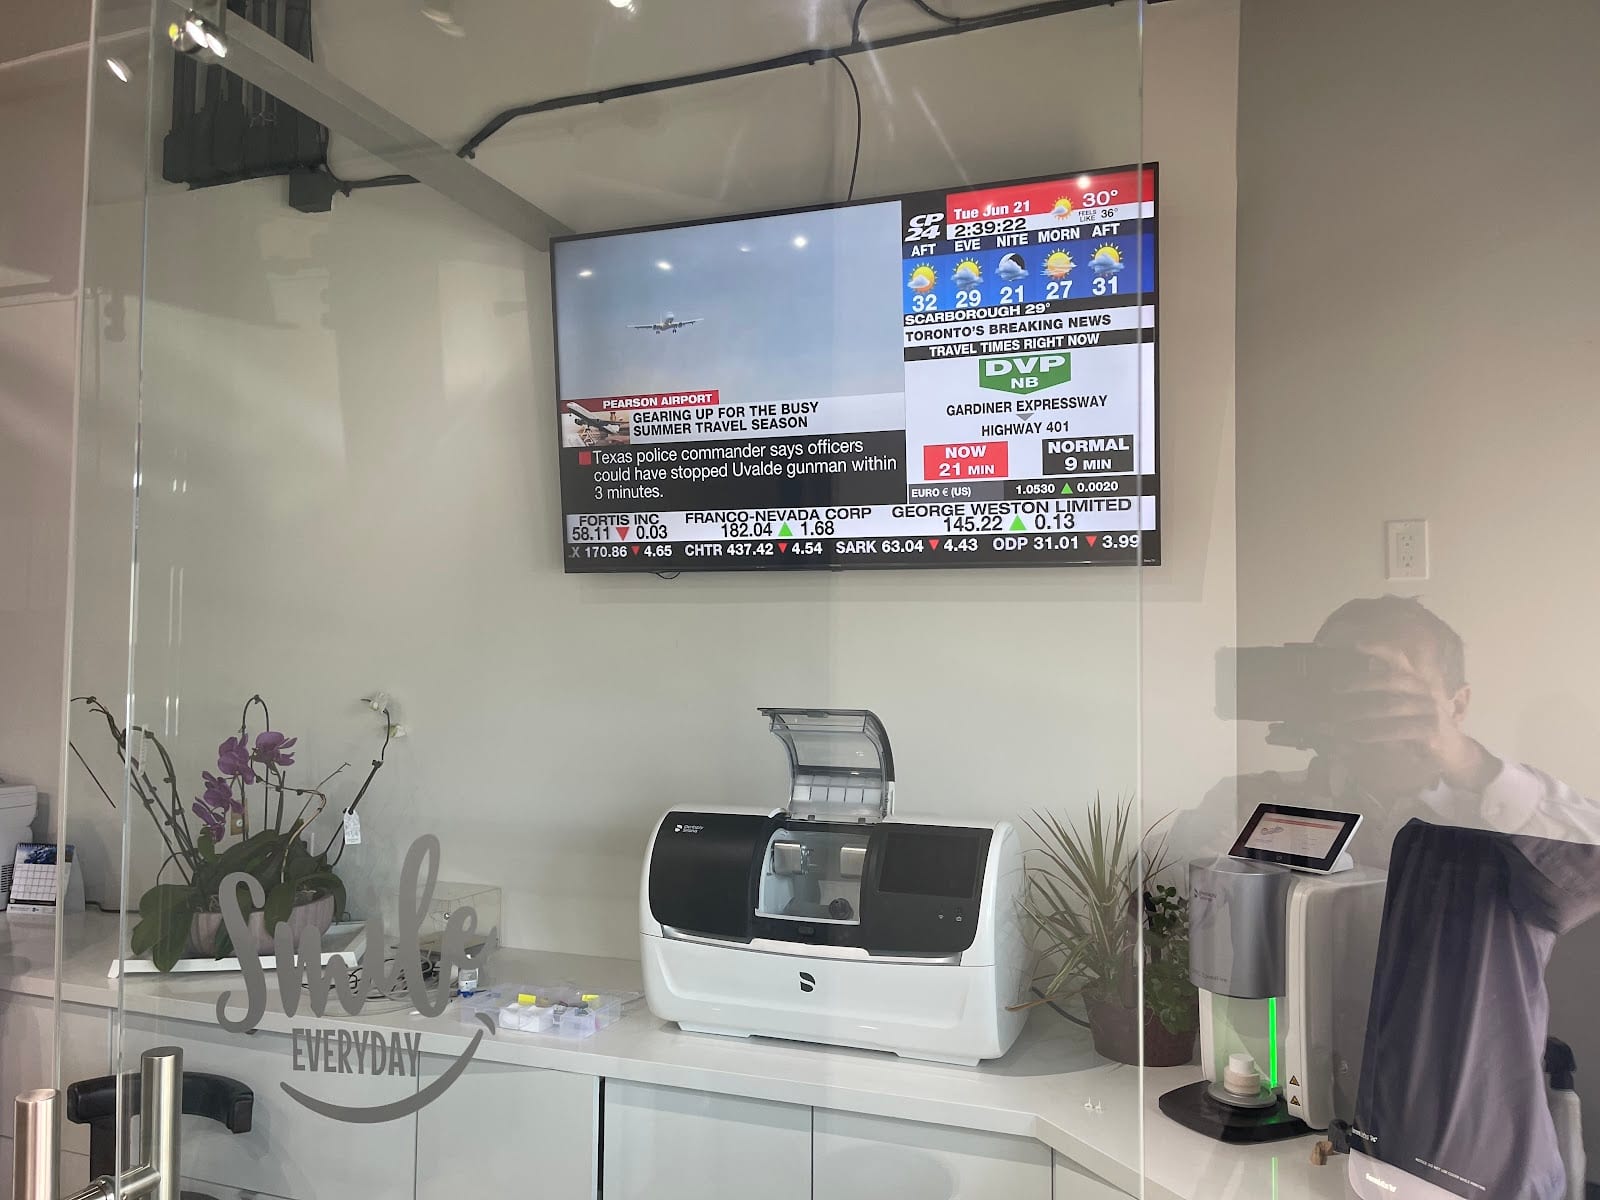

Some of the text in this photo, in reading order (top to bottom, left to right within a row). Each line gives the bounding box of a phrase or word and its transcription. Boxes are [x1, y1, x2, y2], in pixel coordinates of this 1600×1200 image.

[1083, 189, 1118, 208] 30°
[954, 200, 1030, 220] Tue Jun 21
[910, 213, 945, 228] CP
[954, 218, 1026, 238] 2:39:22
[904, 224, 940, 242] 24
[911, 223, 1120, 257] AFT EVE NITE MORN AFT
[912, 277, 1118, 312] 32 29 21 27 31
[905, 306, 1021, 326] SCARBOROUGH
[906, 314, 1112, 342] TORONTO'S BREAKING NEWS
[930, 333, 1100, 358] TRAVEL TIMES RIGHT NOW
[985, 356, 1066, 376] DVP
[1010, 377, 1038, 390] NB
[603, 394, 712, 409] PEARSON AIRPORT
[946, 395, 1108, 416] GARDINER EXPRESSWAY
[634, 402, 818, 424] GEARING UP FOR THE BUSY
[634, 416, 808, 436] SUMMER TRAVEL SEASON
[982, 421, 1070, 436] HIGHWAY 401
[593, 439, 864, 466] Texas police commander says officers
[945, 446, 986, 459] NOW
[1048, 438, 1130, 454] NORMAL
[594, 456, 896, 482] could have stopped Uvalde gunman within
[938, 462, 995, 477] 21 MIN
[1064, 458, 1112, 472] 9 MIN
[594, 485, 664, 500] 3 minutes.
[911, 488, 940, 498] EURO
[950, 486, 972, 498] (US)
[1016, 484, 1056, 494] 1.0530
[1077, 481, 1118, 492] 0.0020
[686, 507, 872, 524] FRANCO-NEVADA CORP
[892, 498, 1132, 518] GEORGE WESTON LIMITED
[580, 513, 660, 526] FORTIS INC
[721, 521, 834, 537] 182.04 1.68
[944, 514, 1074, 532] 145.22 0.13
[572, 524, 668, 540] 58.11 0.03
[585, 546, 628, 558] 170.86
[644, 544, 673, 558] 4.65
[685, 543, 722, 556] CHTR
[726, 542, 774, 556] 437.42
[792, 542, 823, 555] 4.54
[836, 540, 876, 554] SARK
[881, 540, 924, 552] 63.04
[944, 538, 978, 552] 4.43
[992, 538, 1028, 550] ODP
[1034, 536, 1078, 550] 31.01
[1102, 535, 1140, 548] 3.99
[216, 834, 498, 1034] Smile
[292, 1028, 422, 1077] EVERYDAY
